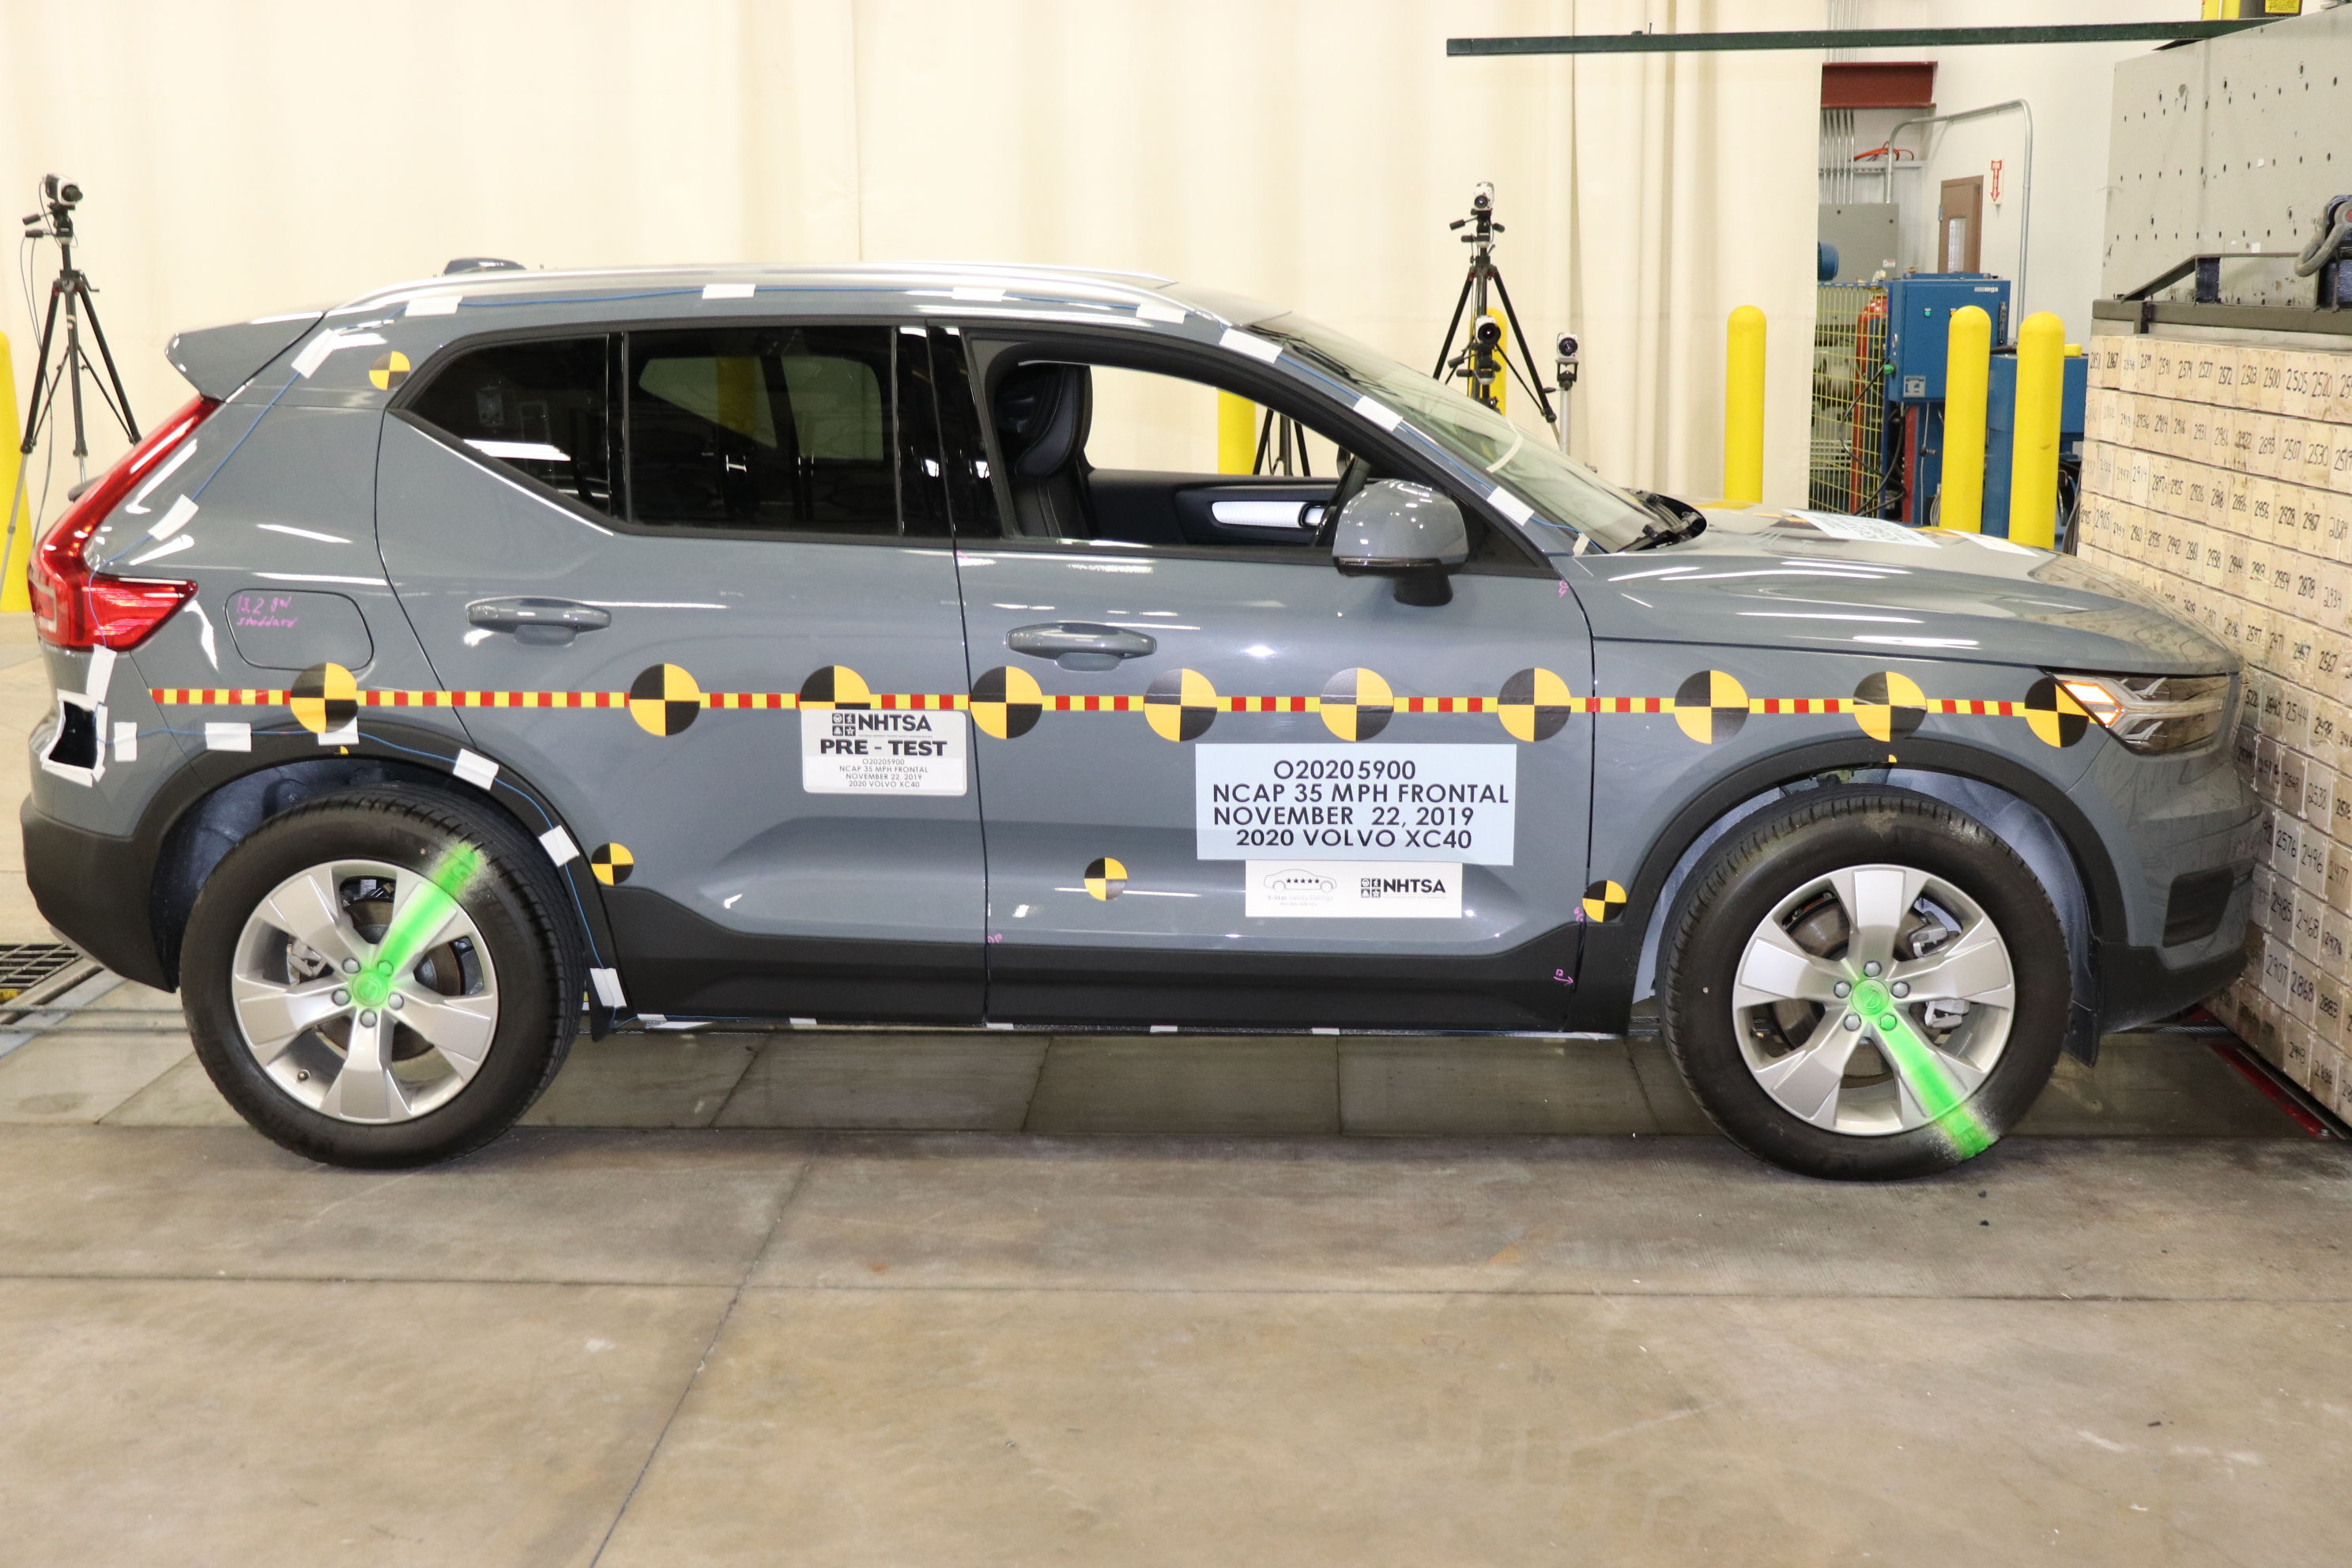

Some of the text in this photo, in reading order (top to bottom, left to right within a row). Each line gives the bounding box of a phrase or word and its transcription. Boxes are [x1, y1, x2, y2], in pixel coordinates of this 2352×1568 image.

[2107, 352, 2118, 369] 2867
[2158, 357, 2171, 375] 2591
[2198, 361, 2213, 378] 2527
[2218, 366, 2232, 385] 2572
[2241, 364, 2257, 385] 2503
[2263, 368, 2281, 389] 2500
[2286, 368, 2308, 394] 2505
[2311, 371, 2332, 398] 2520
[2339, 374, 2352, 398] 25
[2136, 414, 2149, 429] 2936
[2154, 415, 2168, 434] 2904
[2194, 424, 2207, 441] 2931
[2259, 436, 2275, 454] 2893
[2282, 439, 2301, 461] 2507
[2308, 443, 2329, 466] 2530
[2132, 466, 2147, 483] 2914
[2190, 484, 2204, 503] 2926
[2254, 500, 2269, 519] 2956
[2278, 506, 2295, 527] 2928
[2095, 510, 2110, 530] 2905
[2167, 535, 2181, 555] 2942
[2229, 555, 2243, 575] 2944
[2324, 586, 2343, 610] 2934
[858, 714, 932, 732] NHTSA
[2245, 689, 2258, 707] 522
[2286, 702, 2309, 727] 2544
[820, 738, 869, 756] PRE
[888, 740, 948, 756] TEST
[1213, 783, 1510, 804] NCAP 35 MPH FRONTAL
[2308, 783, 2327, 810] 2538
[1214, 806, 1474, 828] NOVEMBER 22, 2019
[1236, 828, 1472, 850] 2020 VOLVO XC40
[2276, 830, 2297, 858] 2576
[2301, 844, 2323, 873] 2496
[1383, 878, 1446, 894] NHTSA
[2271, 891, 2292, 922] 2485
[2296, 909, 2320, 939] 2468
[2266, 955, 2288, 987] 2907
[2290, 971, 2314, 1003] 2868
